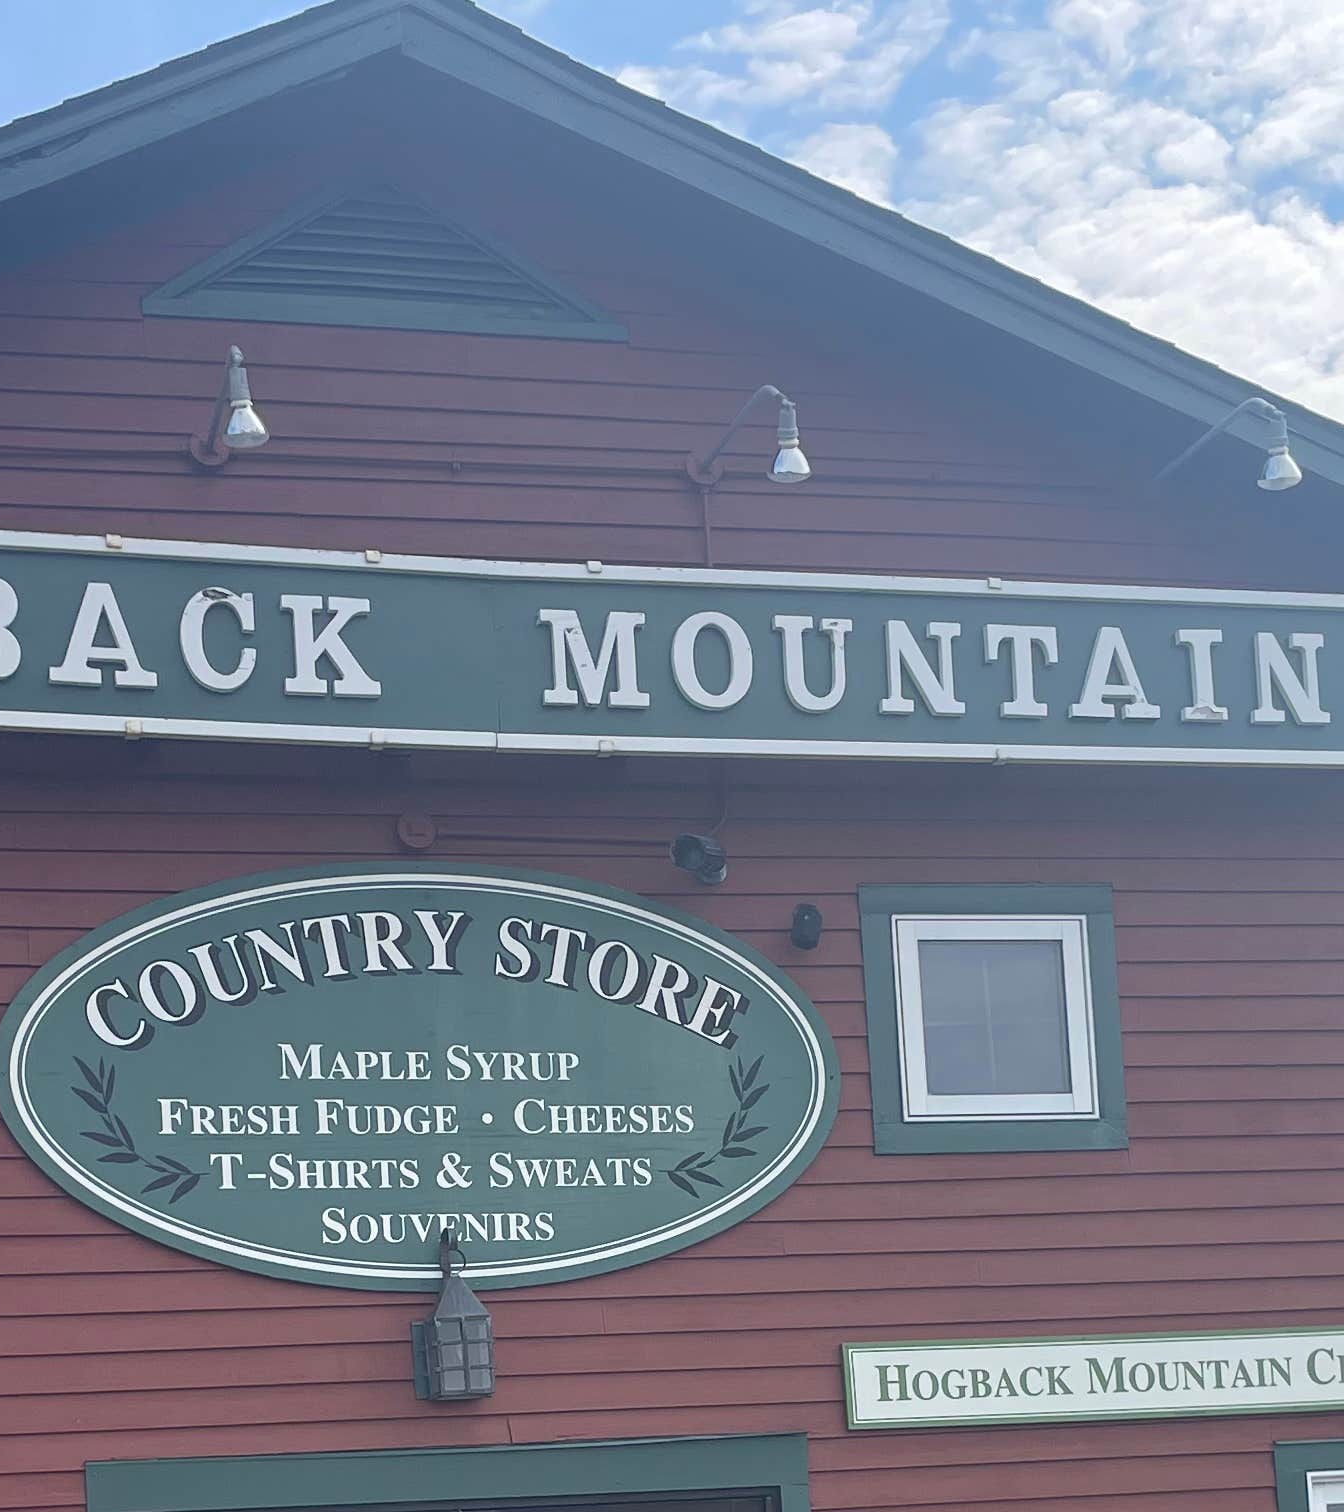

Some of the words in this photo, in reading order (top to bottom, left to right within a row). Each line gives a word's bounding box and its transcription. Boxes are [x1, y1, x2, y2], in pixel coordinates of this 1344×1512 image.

[537, 608, 1332, 725] MOUNTAIN
[85, 909, 467, 1048] COUNTRY
[494, 916, 746, 1047] STORE
[277, 1042, 432, 1081] MAPLE
[446, 1044, 581, 1081] SYRUP
[157, 1098, 299, 1136] FRESH
[313, 1098, 459, 1135] FUDGE
[513, 1098, 695, 1135] CHEESES
[209, 1152, 420, 1191] T-SHIRTS
[435, 1152, 473, 1189] &
[489, 1152, 653, 1188] SWEATS
[321, 1207, 556, 1244] SOUVENIRS
[874, 1362, 1074, 1402] HOGBACK
[1086, 1355, 1293, 1395] MOUNTAIN
